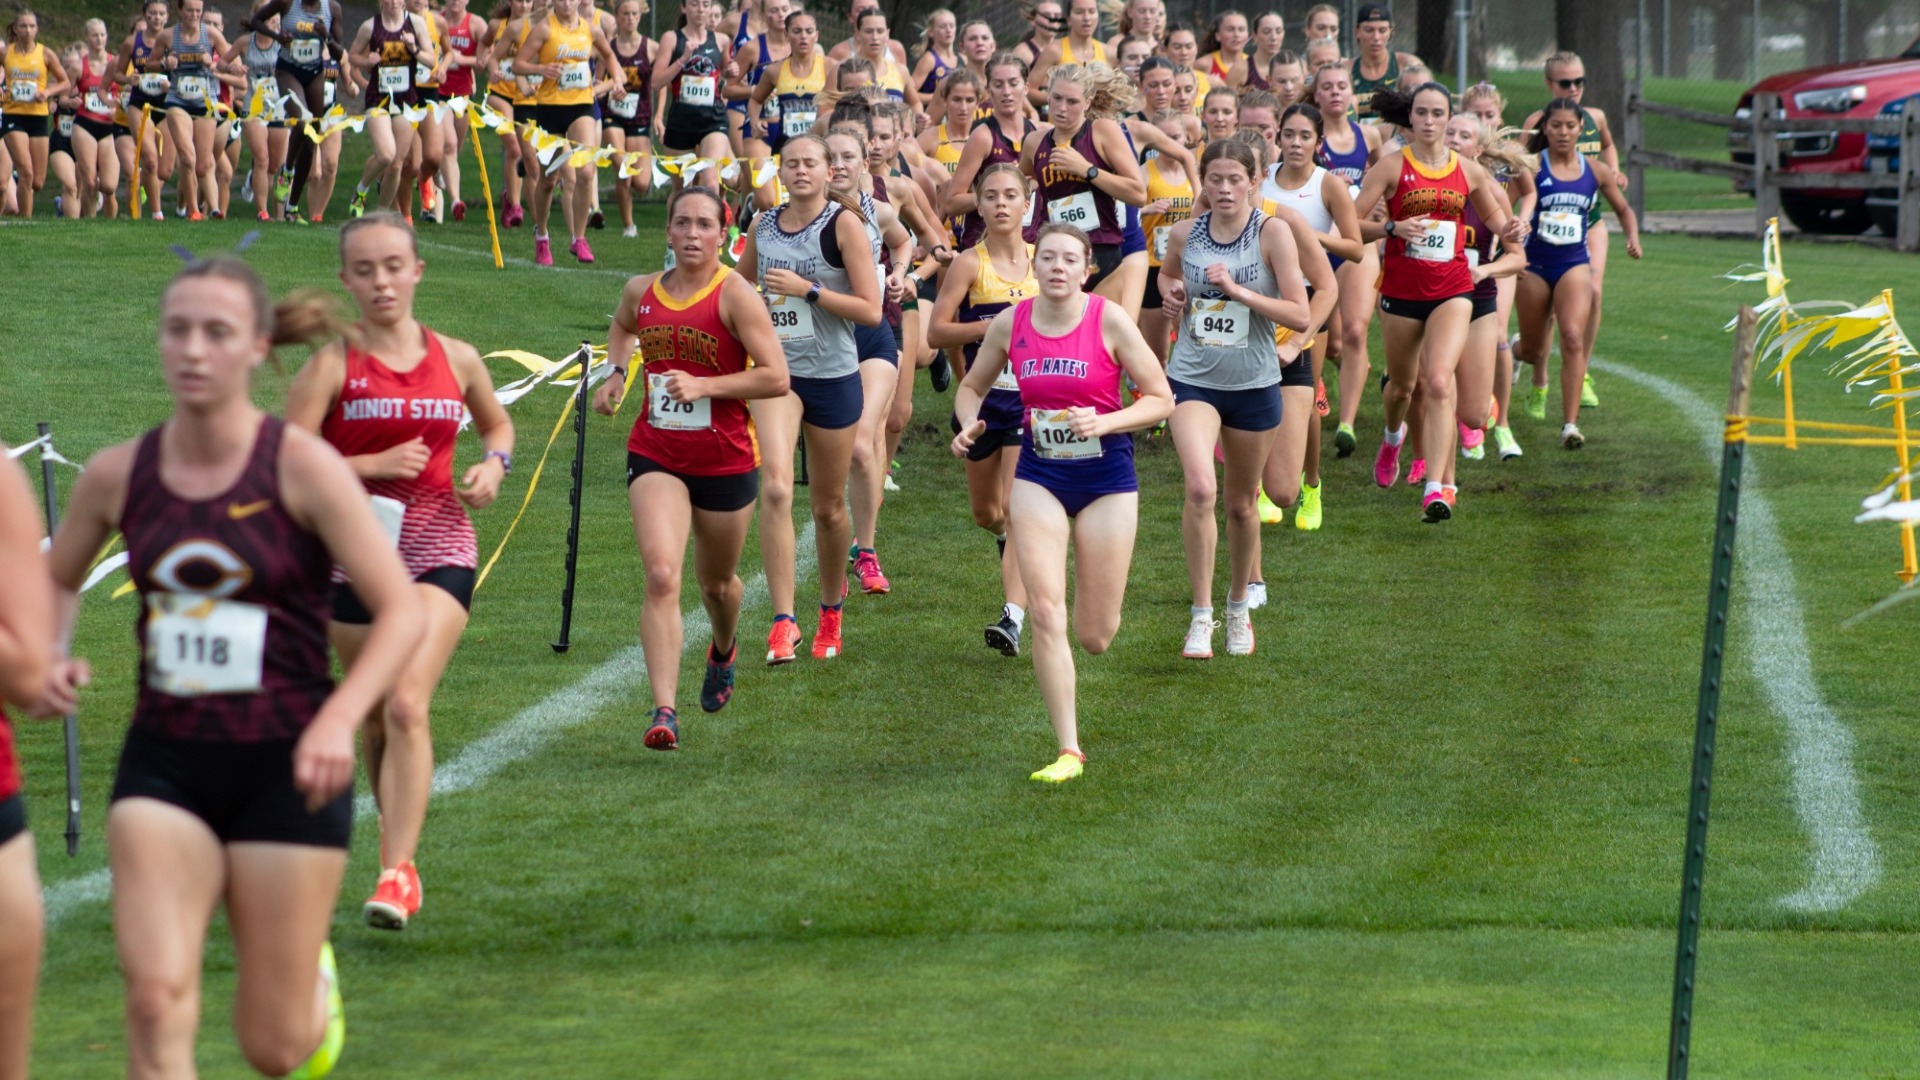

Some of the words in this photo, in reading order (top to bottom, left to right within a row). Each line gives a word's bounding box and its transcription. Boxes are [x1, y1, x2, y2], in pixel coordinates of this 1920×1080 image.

[386, 75, 402, 84] 520
[565, 73, 583, 82] 204
[184, 84, 199, 92] 147
[686, 85, 710, 96] 1019
[1540, 191, 1591, 210] WINONA
[1060, 207, 1086, 223] 566
[1546, 223, 1576, 238] 1218
[795, 256, 817, 277] MINES
[1234, 262, 1259, 285] MINES
[771, 310, 799, 327] 938
[1203, 316, 1235, 334] 942
[678, 325, 719, 370] STATE
[1020, 359, 1038, 380] ST.
[1039, 357, 1089, 379] KATE'S
[342, 398, 406, 421] MINOT
[409, 398, 464, 422] STATE
[176, 632, 230, 667] 118
